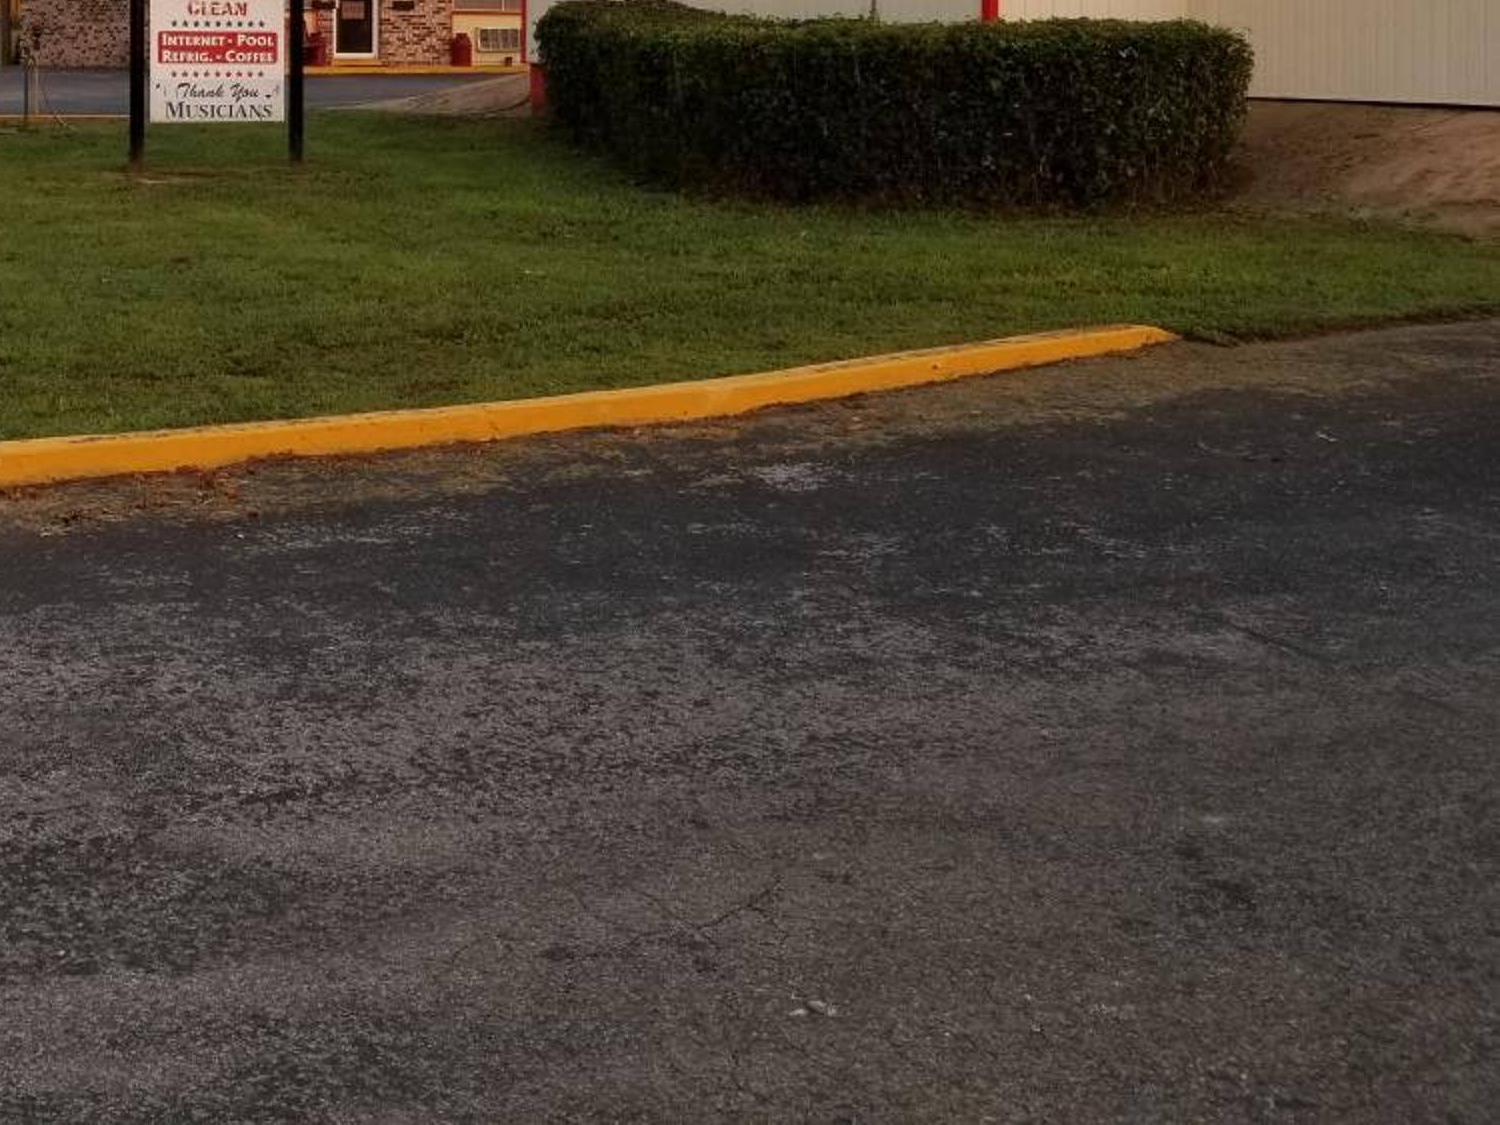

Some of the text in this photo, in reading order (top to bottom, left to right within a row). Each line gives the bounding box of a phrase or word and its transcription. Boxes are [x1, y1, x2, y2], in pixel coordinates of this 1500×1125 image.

[187, 1, 248, 16] CLEAN
[163, 33, 274, 46] INTERNET POOL
[163, 50, 274, 62] REFRIG. COFFEE
[176, 82, 260, 103] Thank You
[165, 101, 273, 119] MUSICIANS
